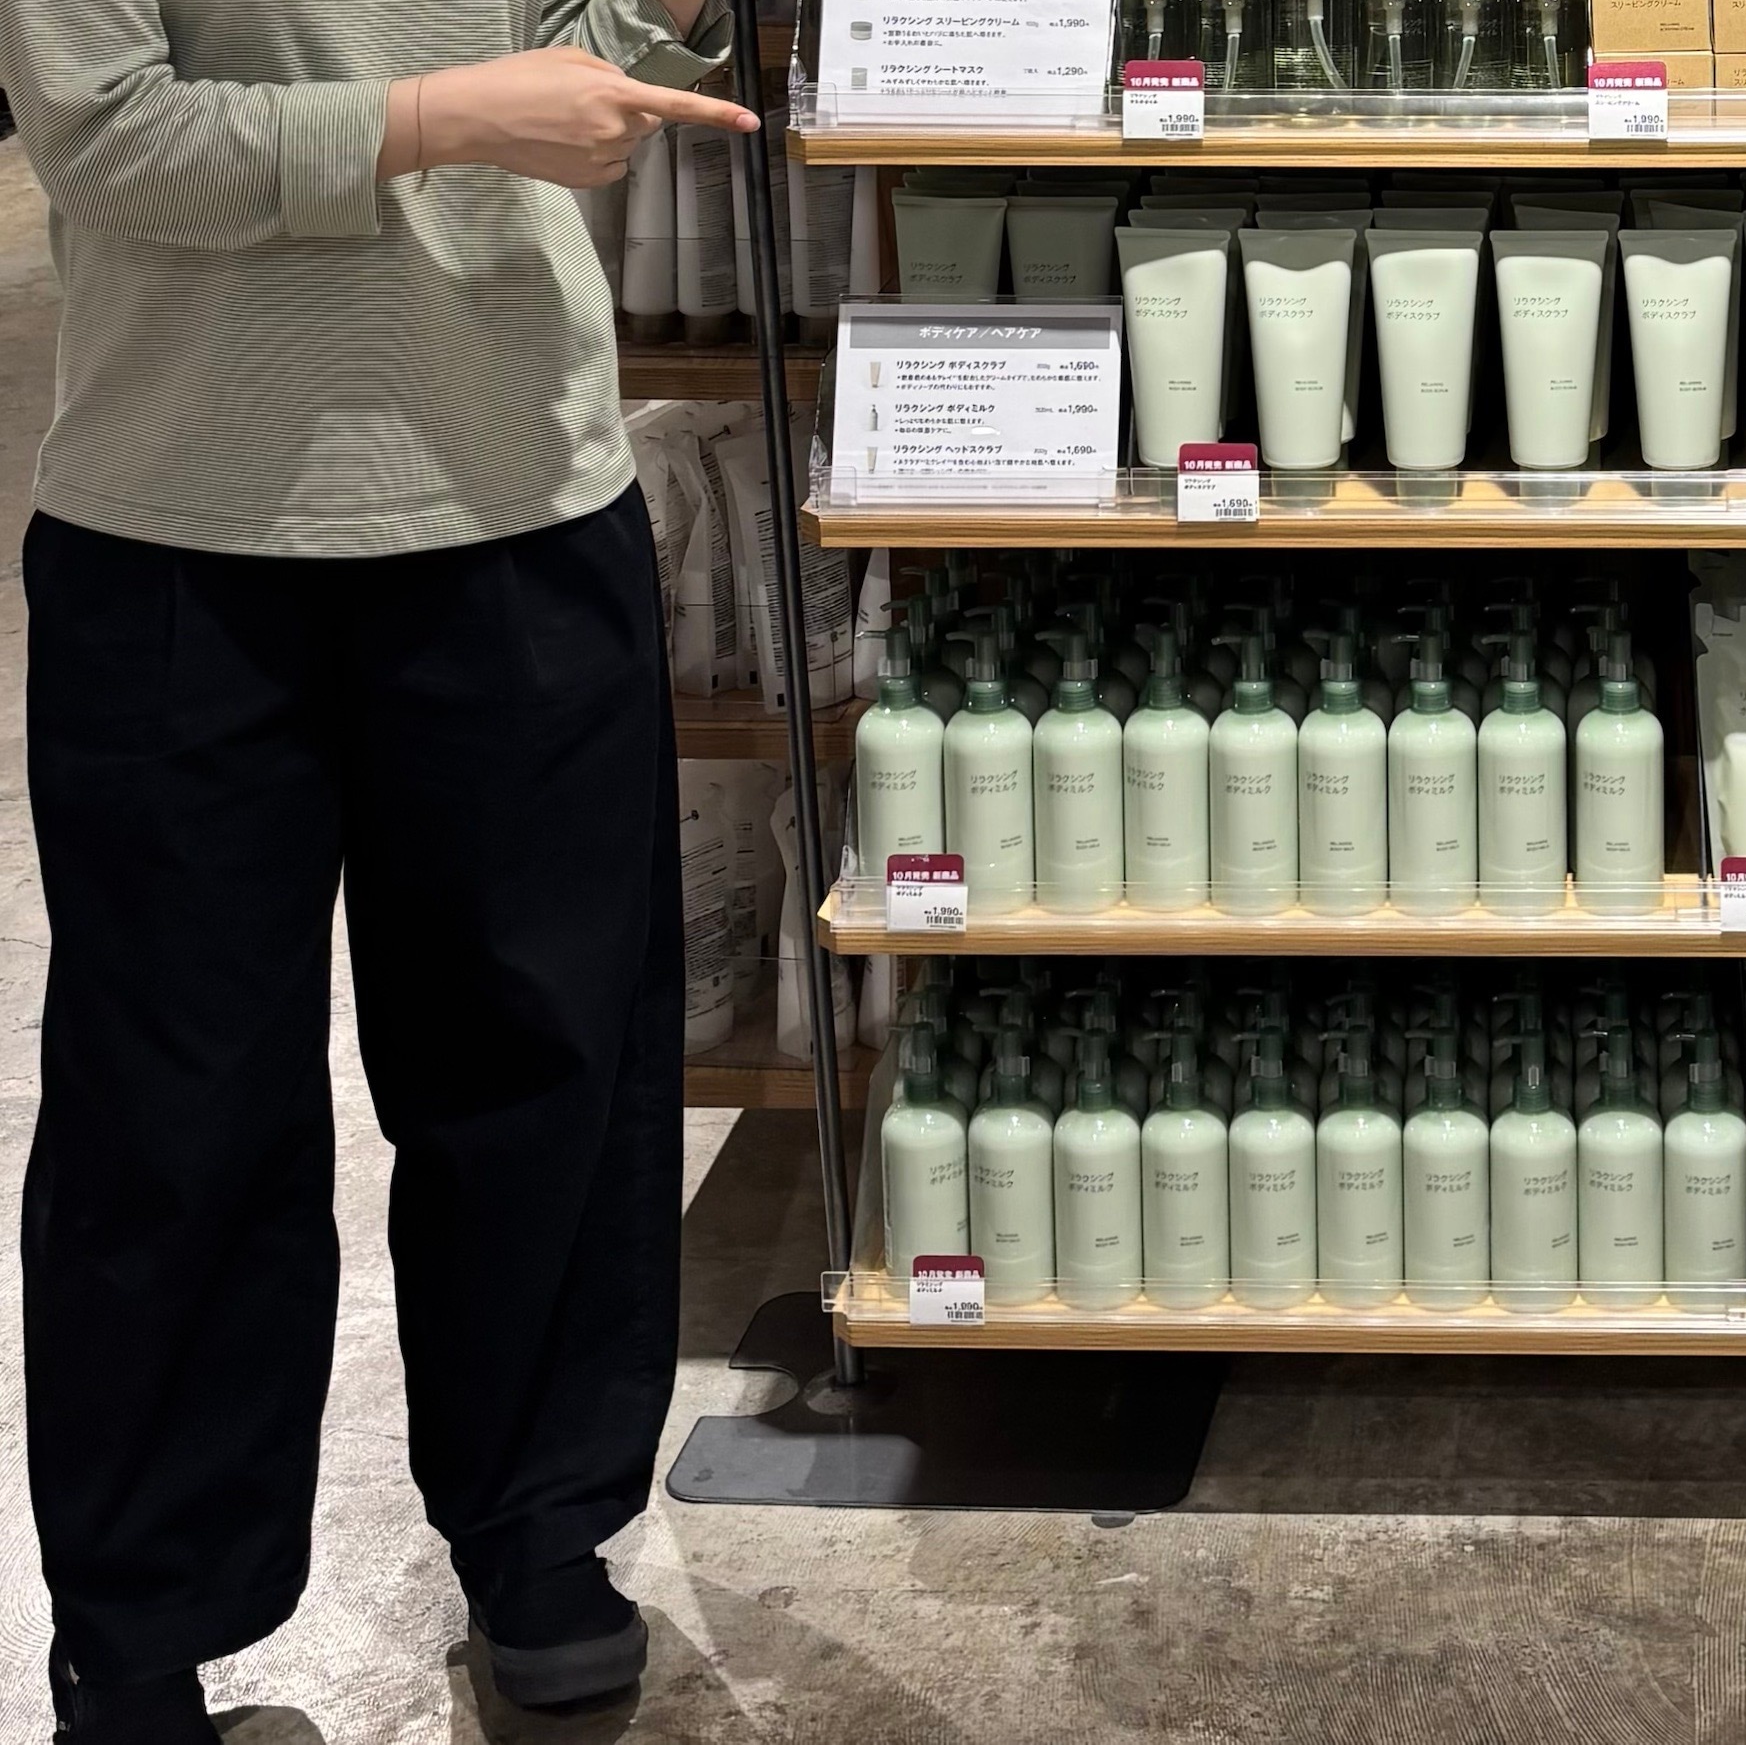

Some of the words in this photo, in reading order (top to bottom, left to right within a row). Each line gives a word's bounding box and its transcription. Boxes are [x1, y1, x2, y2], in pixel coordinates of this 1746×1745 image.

[935, 65, 983, 74] シートマスク
